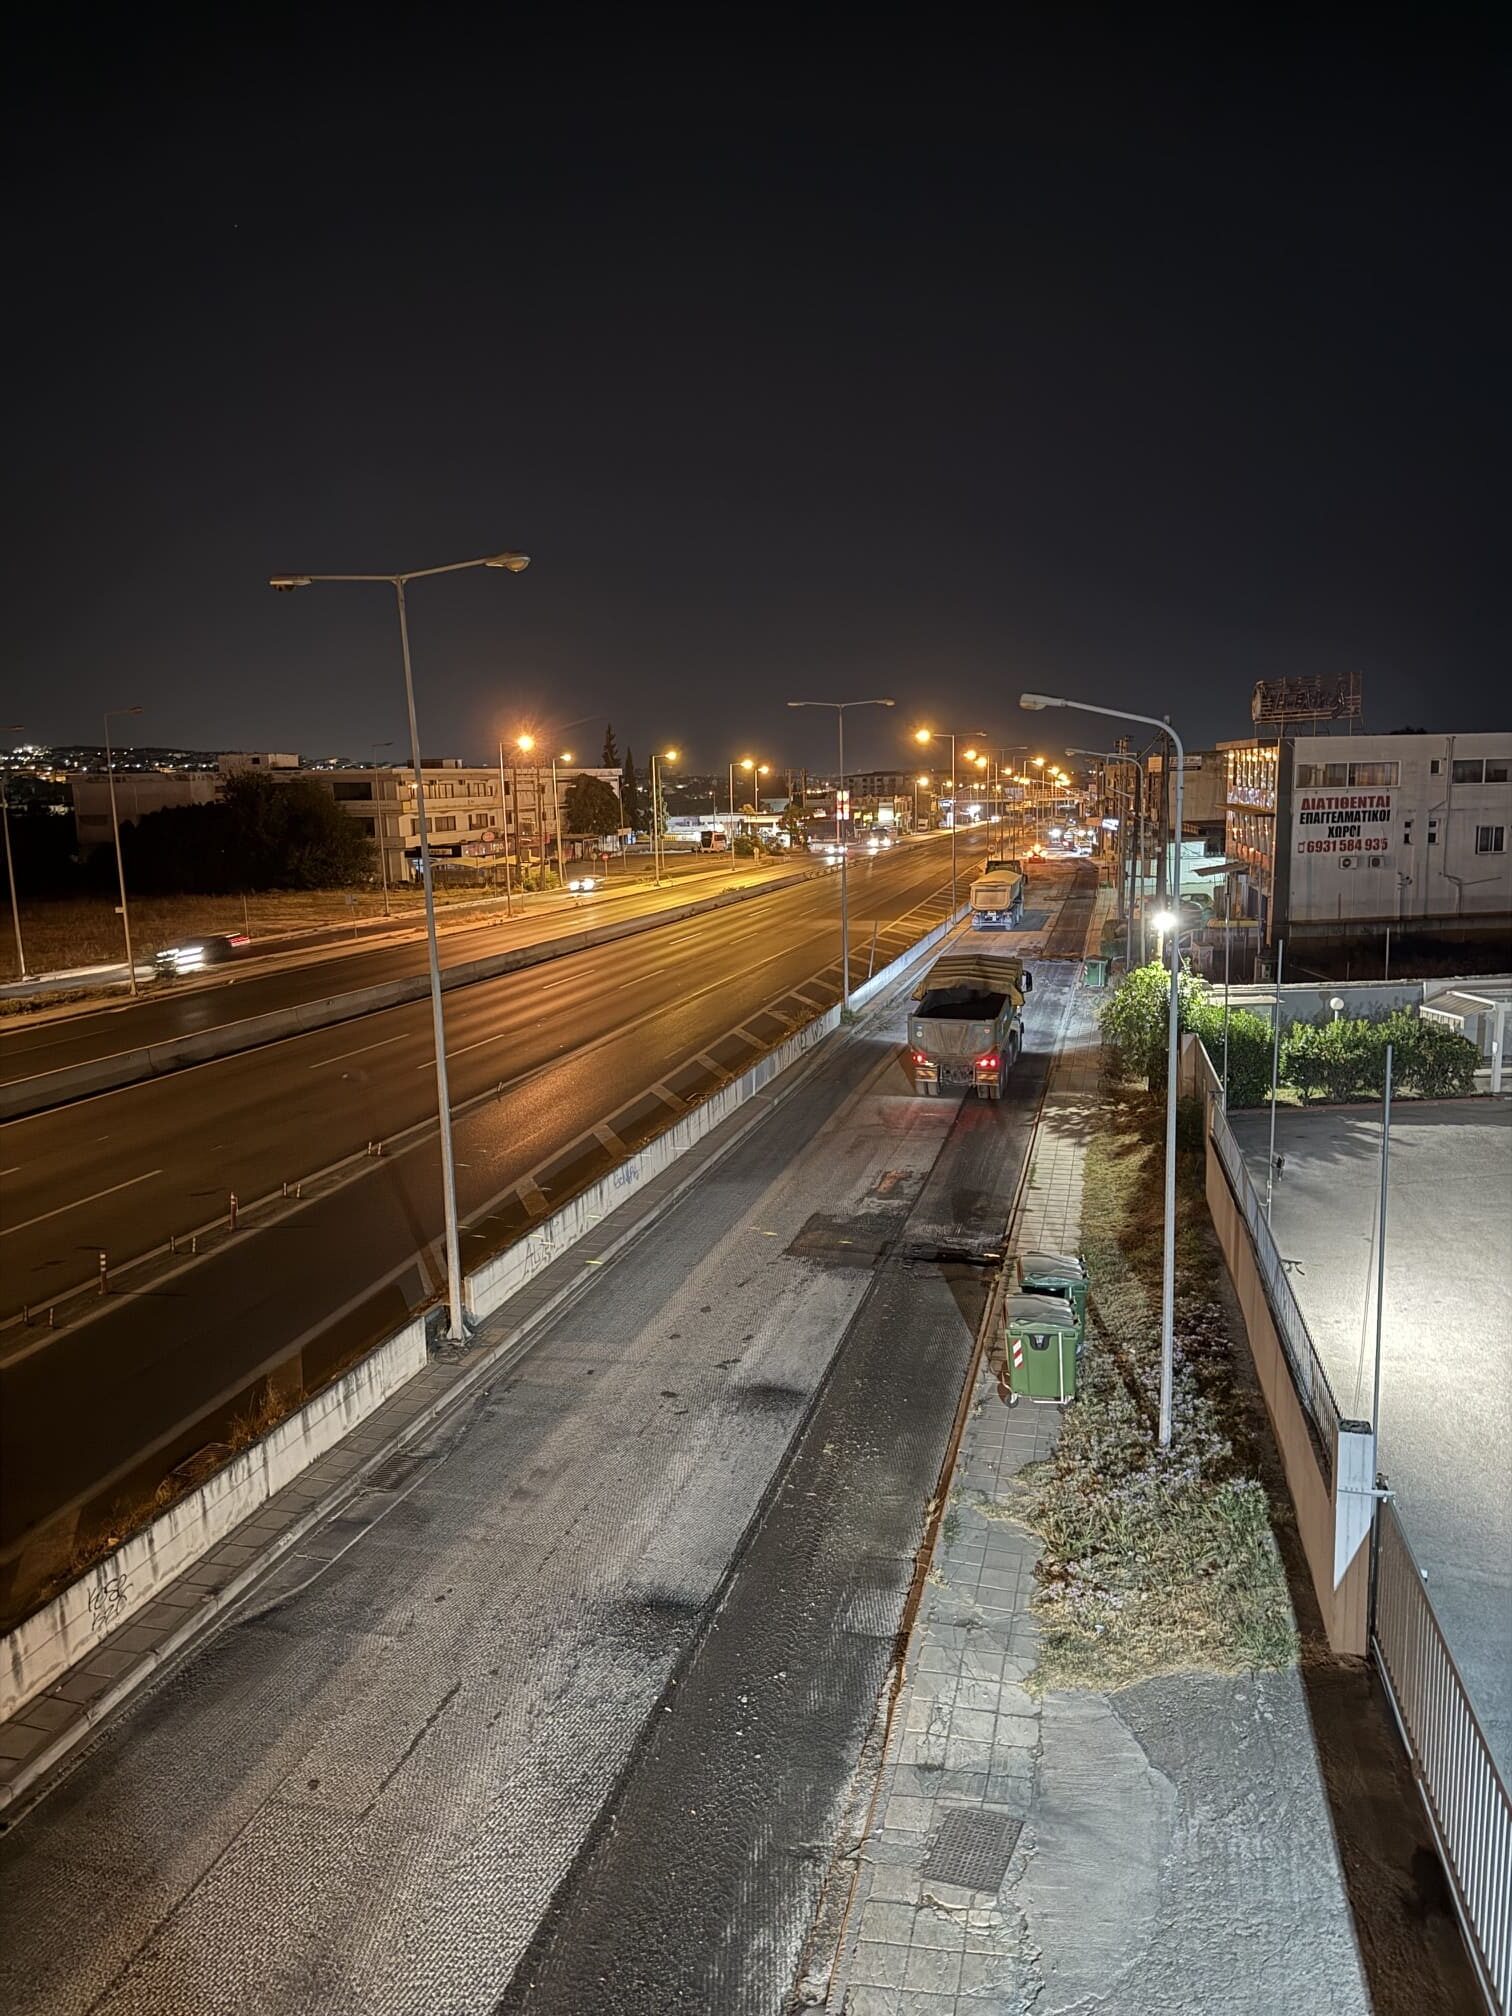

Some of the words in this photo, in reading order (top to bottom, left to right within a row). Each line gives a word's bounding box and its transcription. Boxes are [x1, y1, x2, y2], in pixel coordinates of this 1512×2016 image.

[1301, 796, 1391, 811] ΔΙΑΤΙΘΕΝΤΑΙ
[1300, 810, 1391, 824] ΕΠΑΓΓΕΛΜΑΤΙΚΟΙ
[1328, 825, 1361, 838] ΧΩΡΟΙ
[1307, 840, 1336, 853] 6931
[1340, 838, 1361, 852] 584
[1365, 838, 1388, 851] 935
